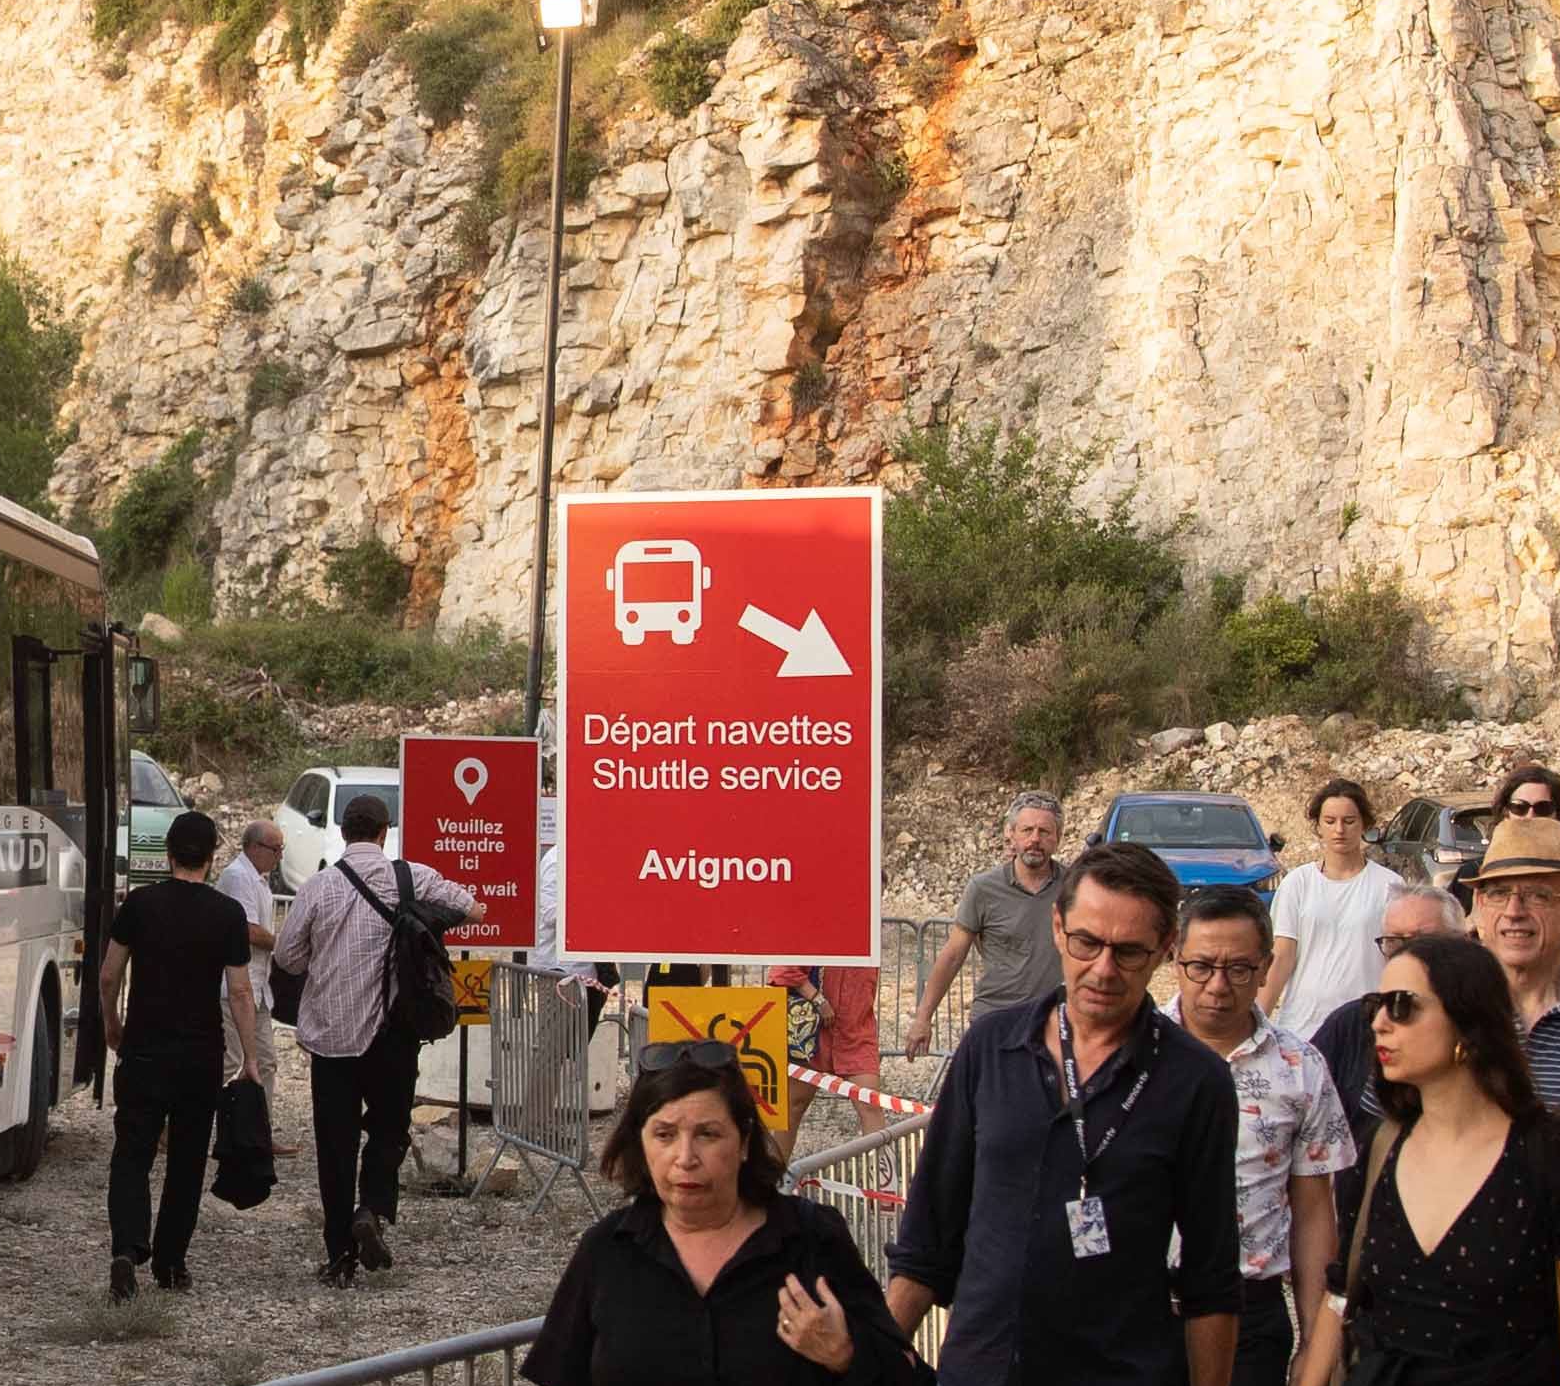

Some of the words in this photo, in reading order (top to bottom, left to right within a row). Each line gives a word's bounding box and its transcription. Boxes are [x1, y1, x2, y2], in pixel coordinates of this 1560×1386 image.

[583, 713, 696, 752] Départ
[707, 715, 852, 745] navettes
[592, 758, 709, 790] Shuttle
[720, 759, 842, 790] service
[436, 818, 503, 834] Veuillez
[434, 837, 504, 853] attendre
[460, 855, 479, 870] ici
[639, 849, 791, 888] Avignon
[482, 881, 517, 896] wait
